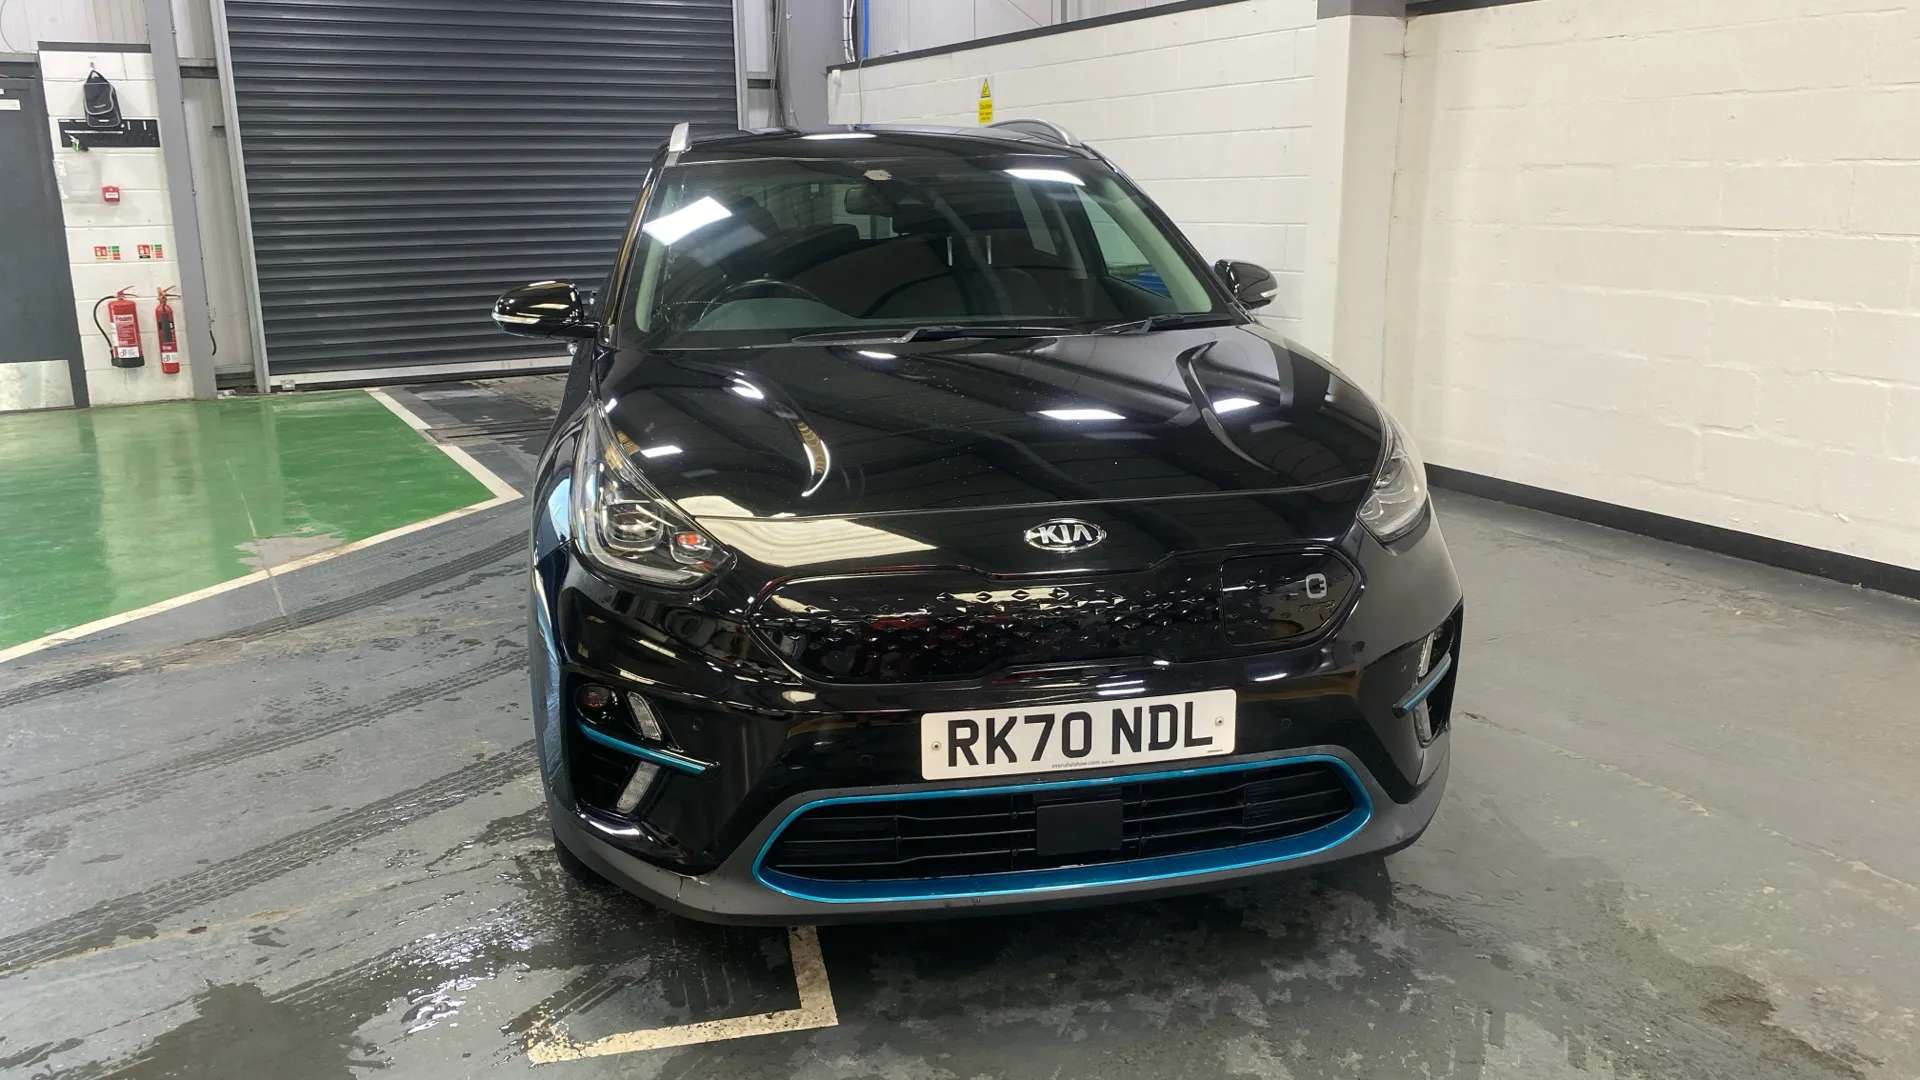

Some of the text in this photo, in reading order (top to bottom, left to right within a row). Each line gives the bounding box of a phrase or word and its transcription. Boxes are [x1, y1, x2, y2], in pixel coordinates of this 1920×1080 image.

[1038, 524, 1093, 544] KIA
[948, 702, 1213, 767] RK70 NDL
